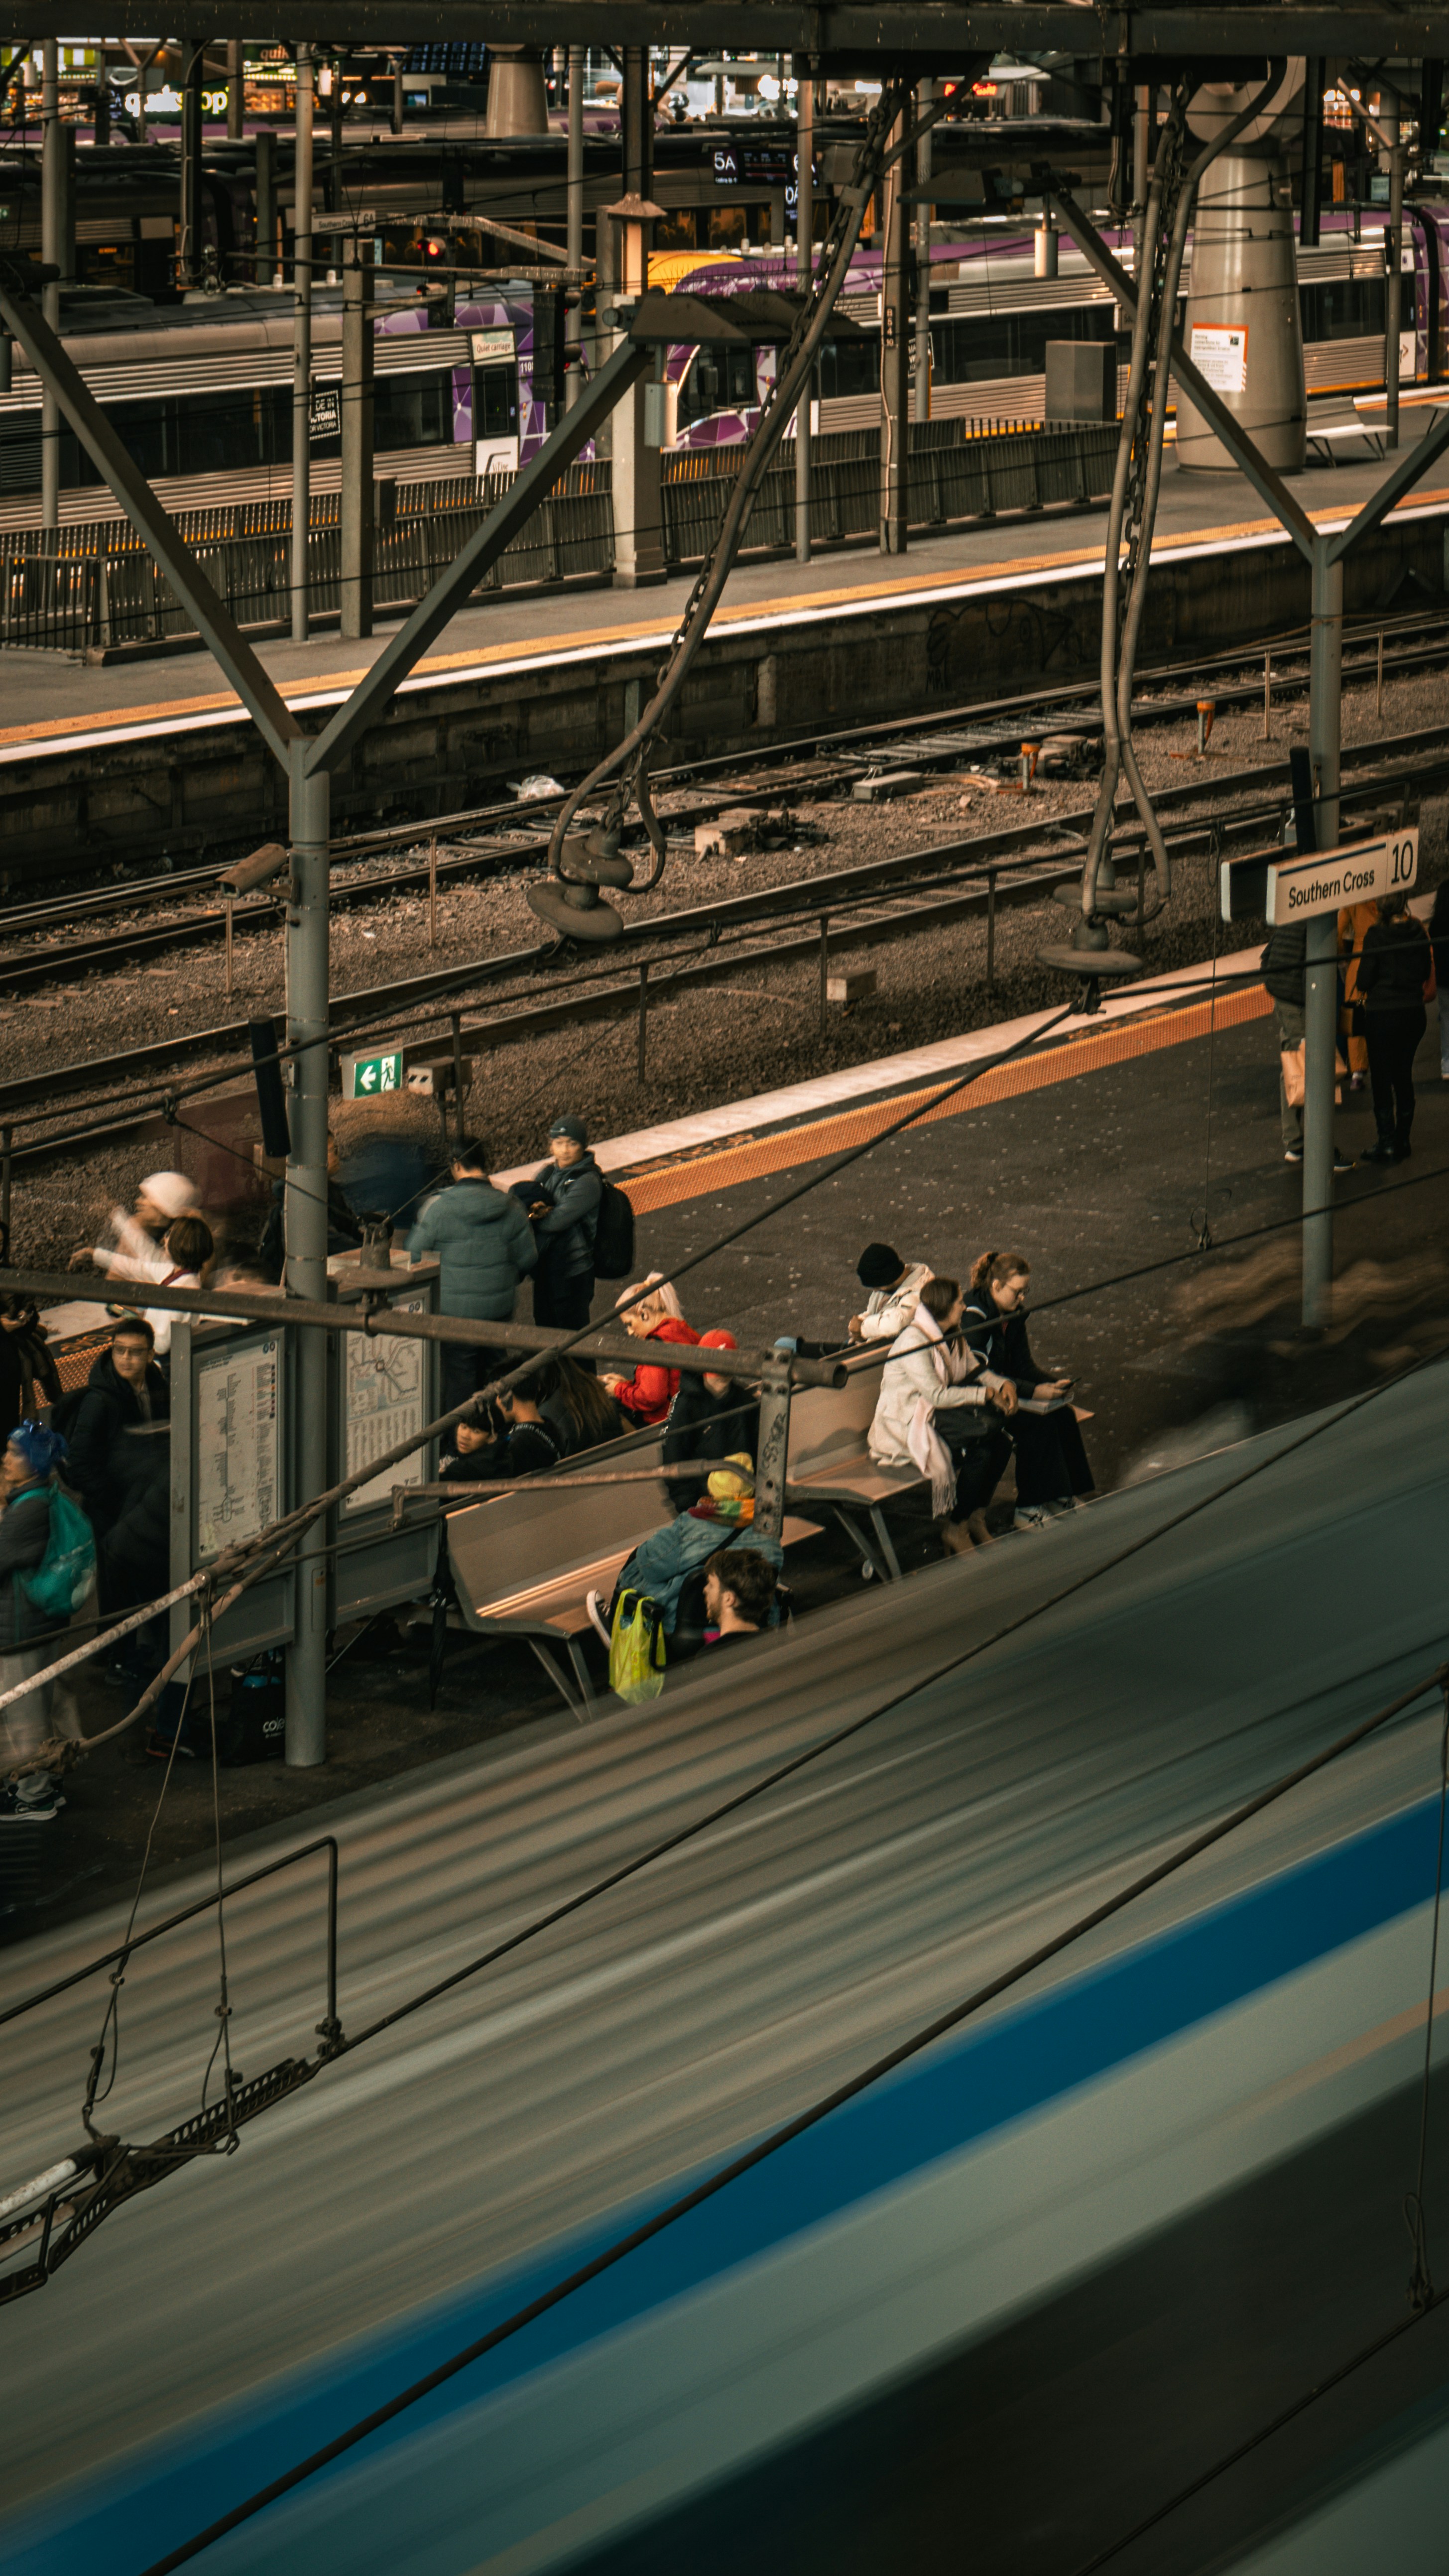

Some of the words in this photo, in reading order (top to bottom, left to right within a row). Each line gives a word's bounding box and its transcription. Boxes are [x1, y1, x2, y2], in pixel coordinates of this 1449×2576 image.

[714, 151, 735, 170] 5A
[363, 213, 373, 228] 6A
[477, 344, 490, 354] Quiet
[491, 342, 511, 352] carriage
[520, 361, 533, 373] 110
[311, 409, 337, 424] ICTORIA
[1288, 879, 1340, 909] Southern
[1343, 869, 1375, 893] Cross
[1391, 840, 1414, 884] 10
[262, 1717, 285, 1733] cole
